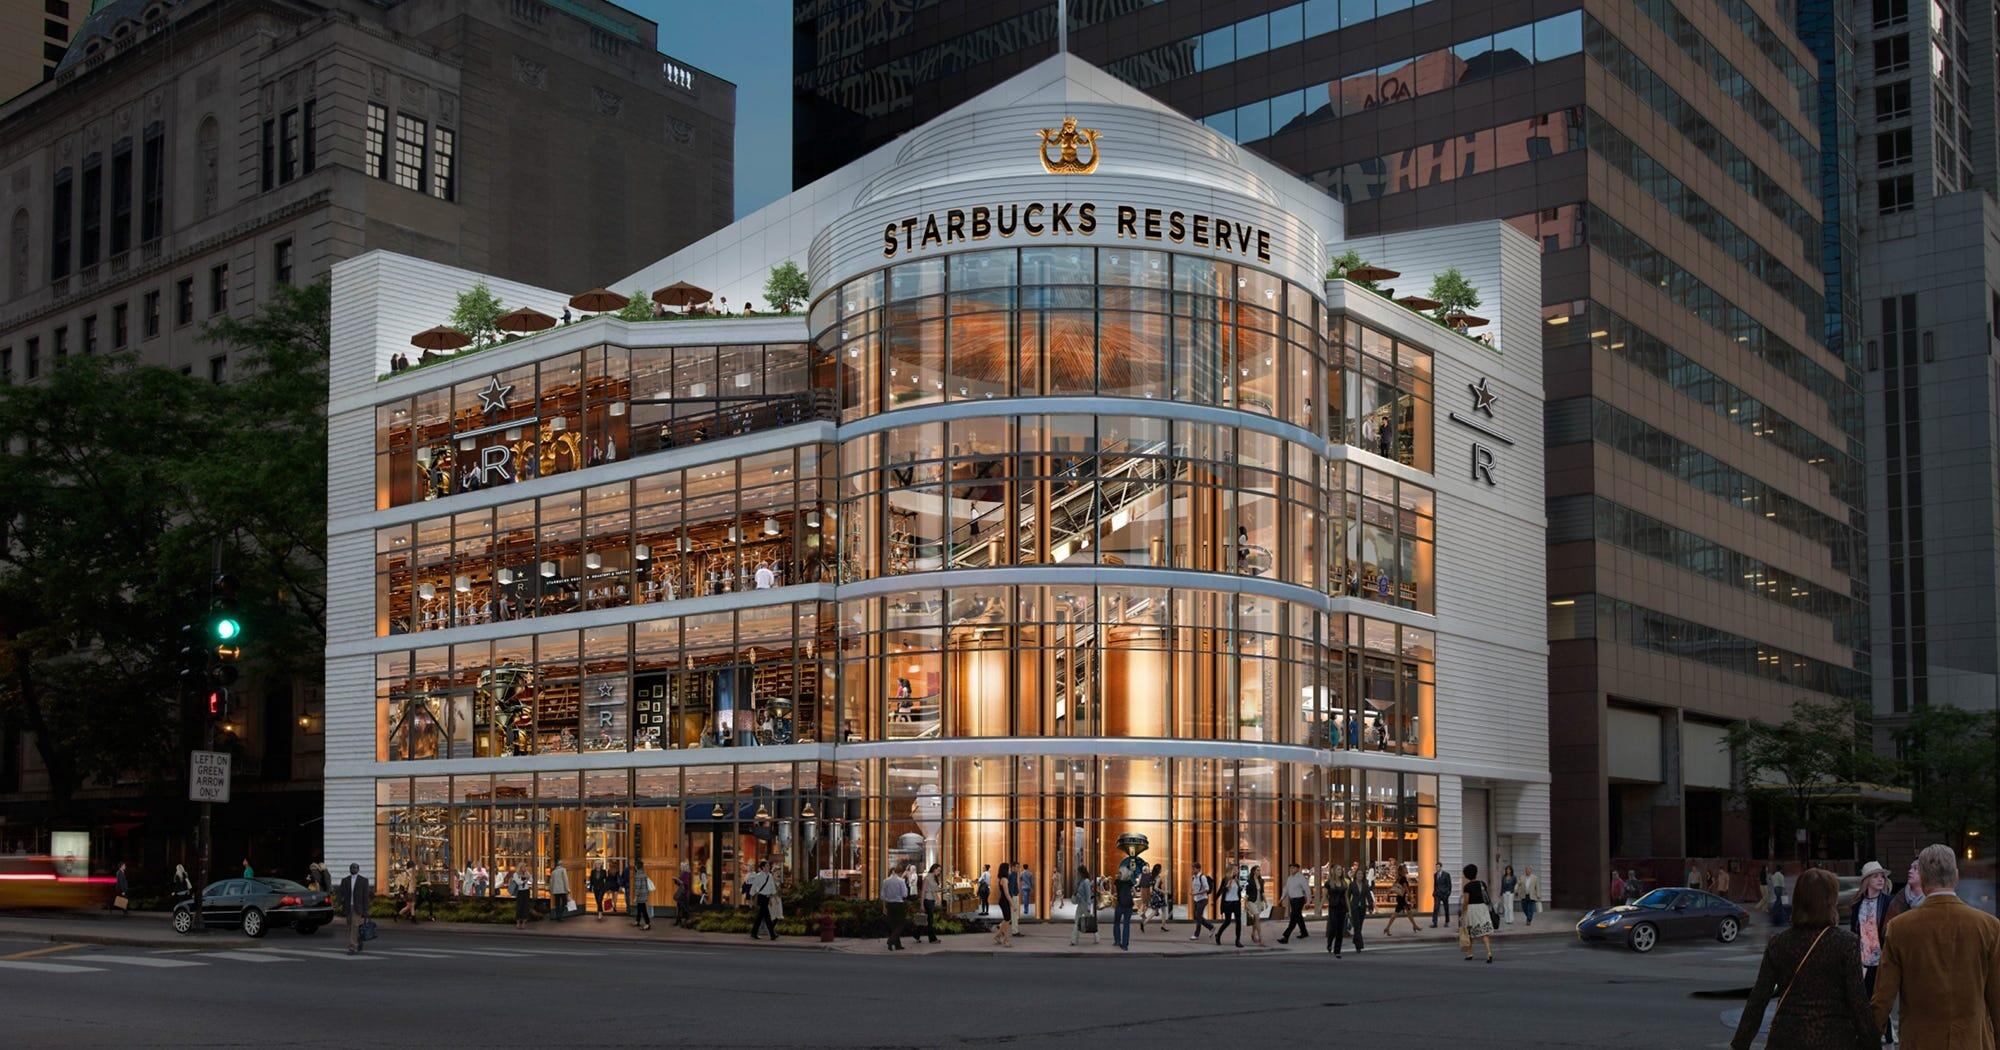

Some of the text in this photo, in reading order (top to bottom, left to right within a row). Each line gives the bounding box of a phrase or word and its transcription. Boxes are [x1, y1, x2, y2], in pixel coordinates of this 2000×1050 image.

[883, 201, 1272, 263] STARBUCKS RESERVE
[481, 444, 510, 483] R
[1472, 442, 1497, 485] R
[599, 710, 613, 727] R
[194, 754, 228, 765] LEFT ON
[197, 765, 224, 776] GREEN
[196, 776, 224, 787] ARROW
[199, 787, 219, 797] ONLY
